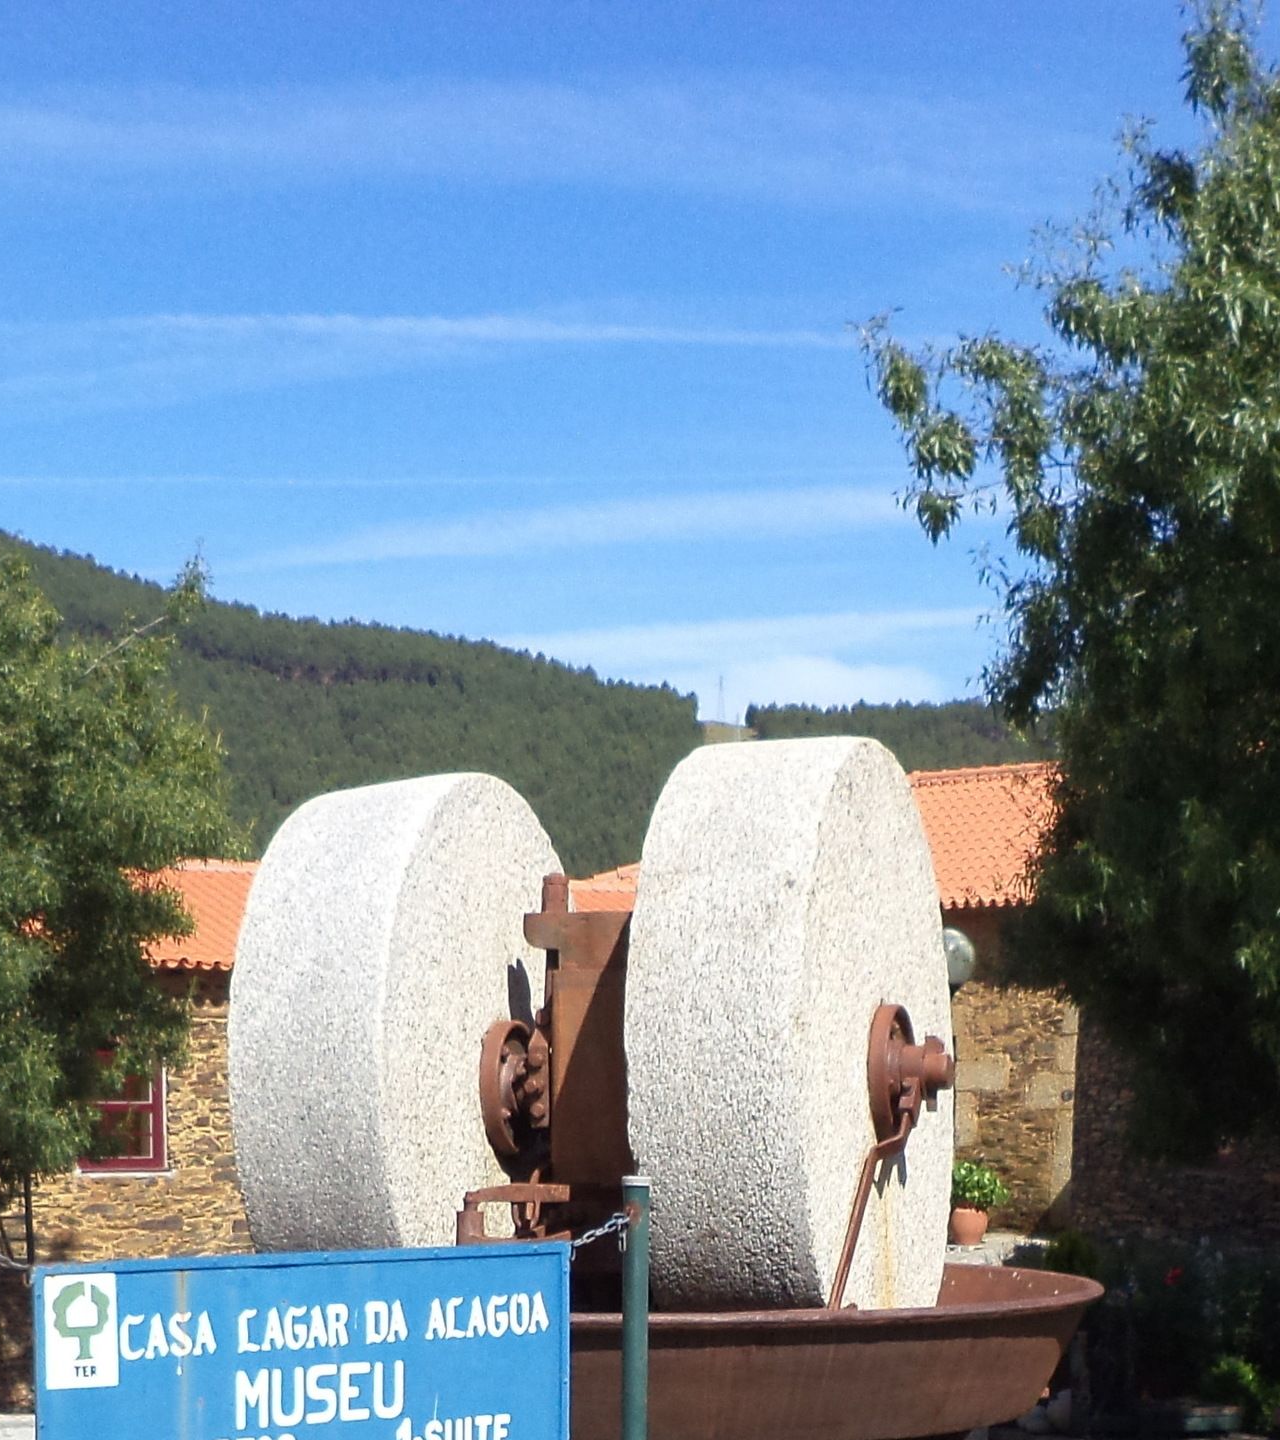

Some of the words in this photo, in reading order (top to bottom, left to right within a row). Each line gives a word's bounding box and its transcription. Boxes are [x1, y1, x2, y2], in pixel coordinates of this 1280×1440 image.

[120, 1309, 216, 1361] CASA
[366, 1299, 408, 1345] DA
[235, 1360, 405, 1430] MUSEU
